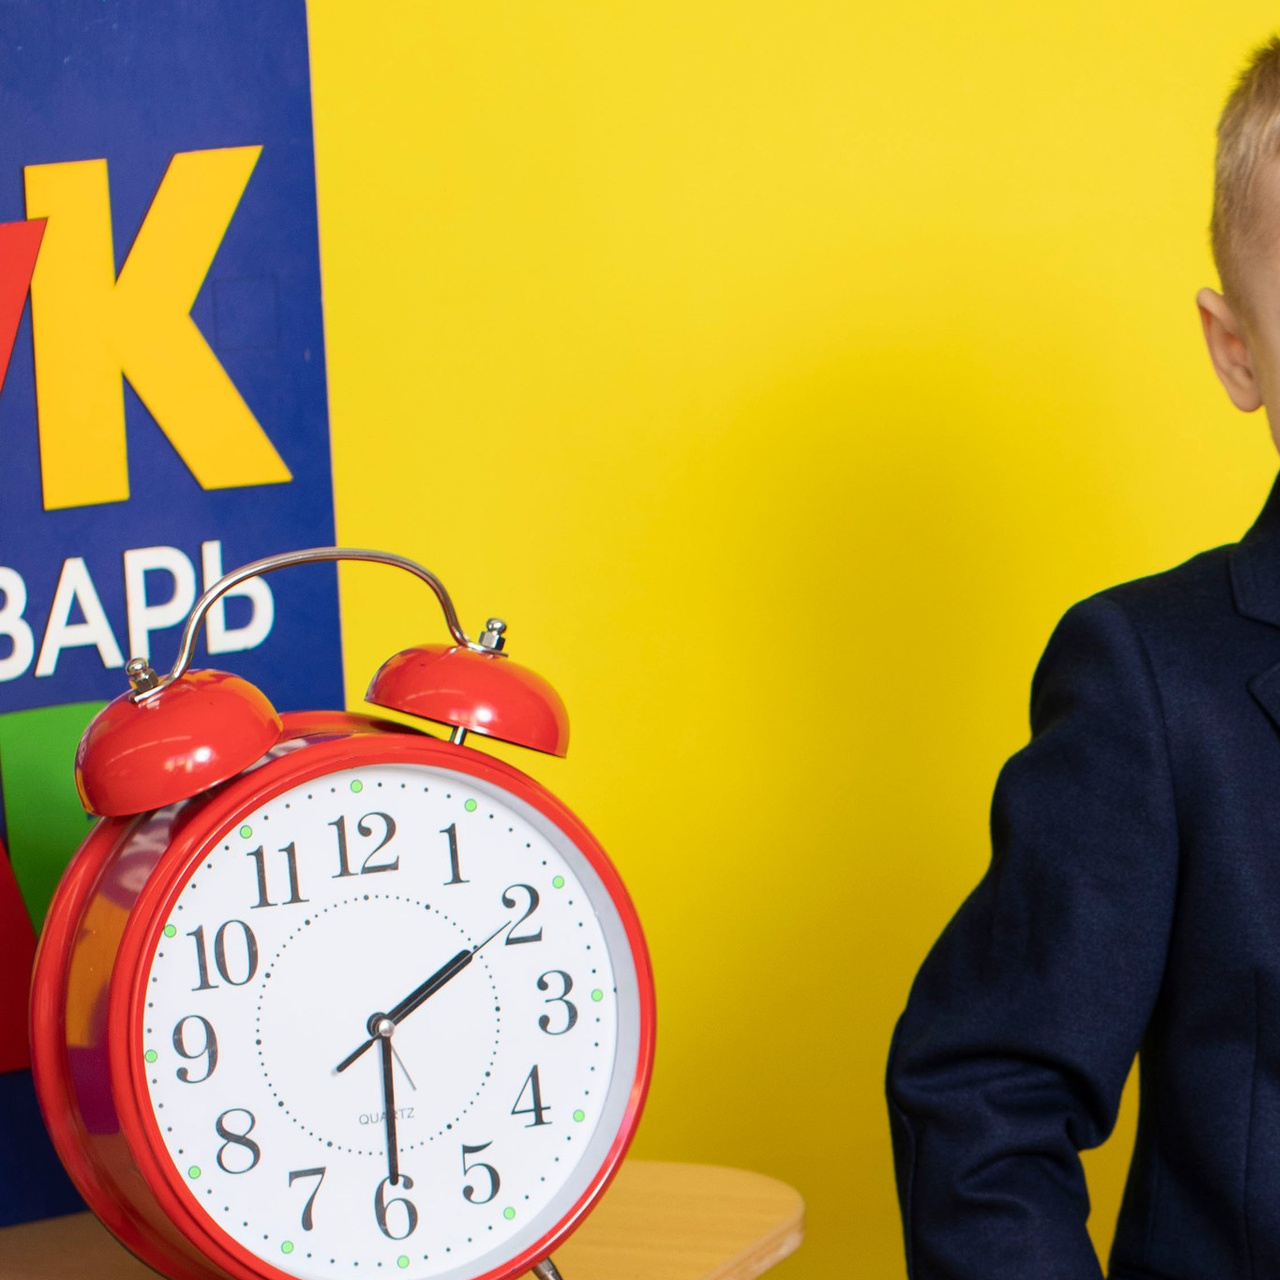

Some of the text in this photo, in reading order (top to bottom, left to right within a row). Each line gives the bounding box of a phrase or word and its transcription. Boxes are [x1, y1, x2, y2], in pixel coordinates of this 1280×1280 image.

[0, 145, 293, 512] К
[247, 842, 309, 909] 11
[328, 812, 399, 878] 12
[440, 823, 469, 885] 1
[502, 884, 542, 945] 2
[187, 920, 258, 991] 10
[537, 970, 577, 1035] 3
[172, 1015, 218, 1083] 9
[359, 1107, 415, 1125] QUATZ
[511, 1065, 551, 1127] 4
[216, 1109, 260, 1174] 8
[462, 1141, 500, 1204] 5
[289, 1167, 326, 1231] 7
[375, 1174, 418, 1240] 6
